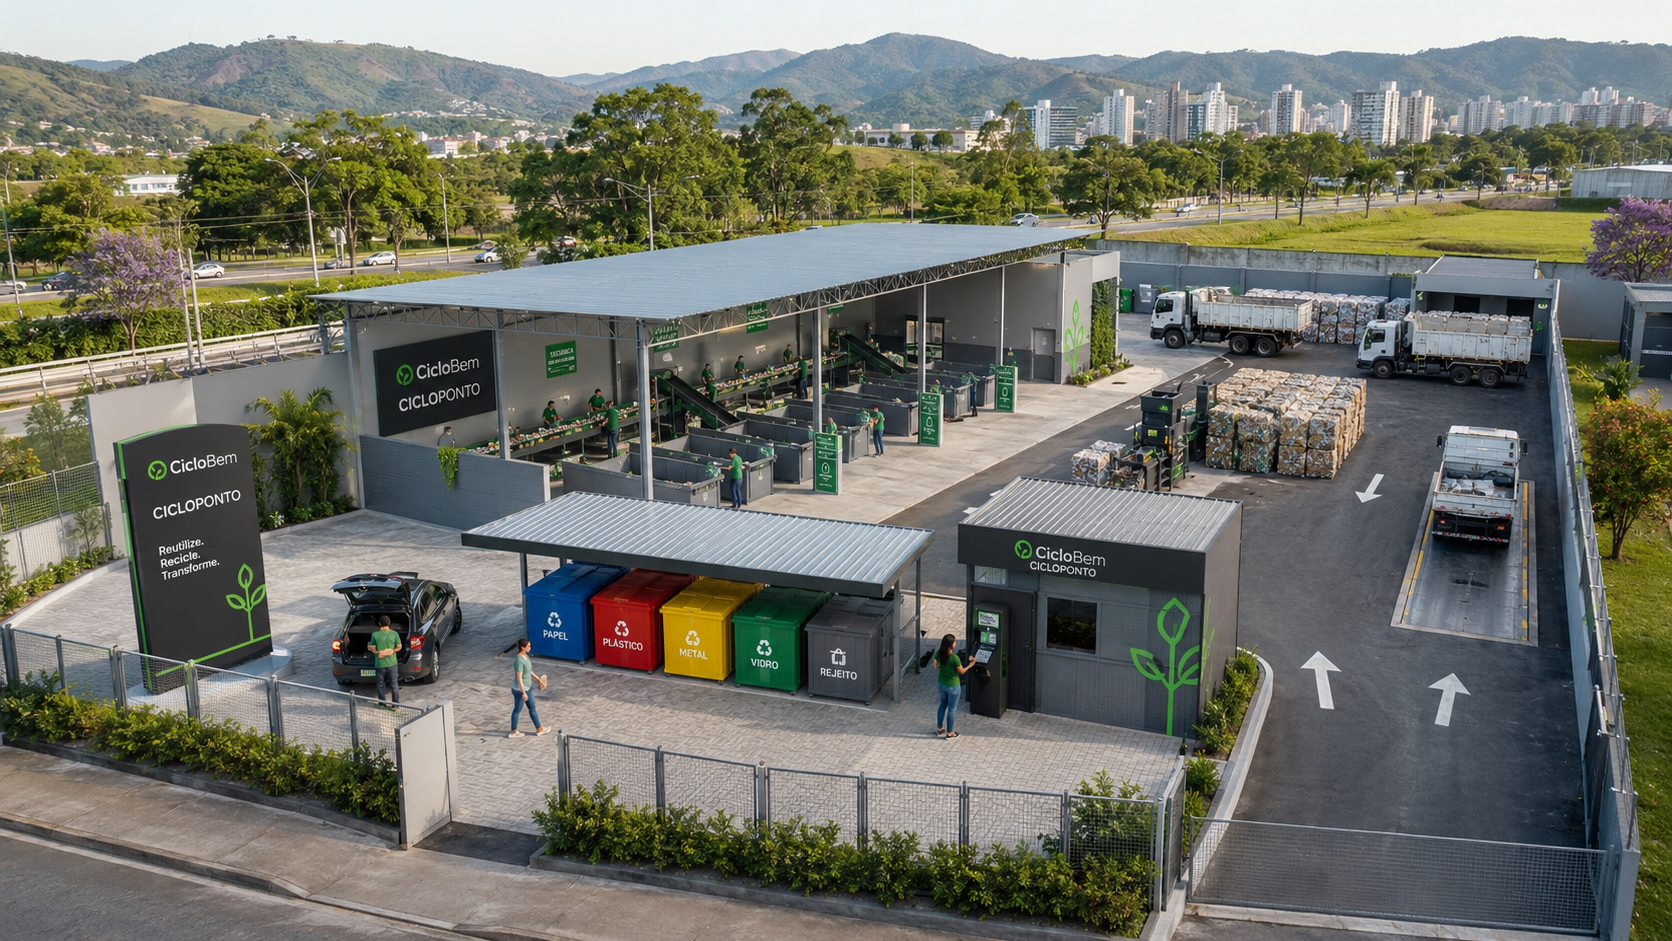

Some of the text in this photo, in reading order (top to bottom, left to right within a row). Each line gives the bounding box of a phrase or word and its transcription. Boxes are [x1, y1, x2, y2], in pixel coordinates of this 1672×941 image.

[416, 358, 480, 380] CicloBem
[398, 382, 481, 412] CICLOPONTO
[170, 453, 238, 474] CicloBem
[152, 489, 241, 520] CICLOPONTO
[158, 538, 204, 556] Reutilize.
[160, 551, 201, 569] Recicle.
[1035, 546, 1106, 567] CicloBem
[161, 559, 220, 581] Transforme.
[1029, 560, 1097, 578] CICLOPONTO
[542, 629, 569, 641] PAPEL
[679, 647, 708, 660] METAL
[750, 657, 779, 670] VIDRO
[820, 667, 858, 681] REJEITO
